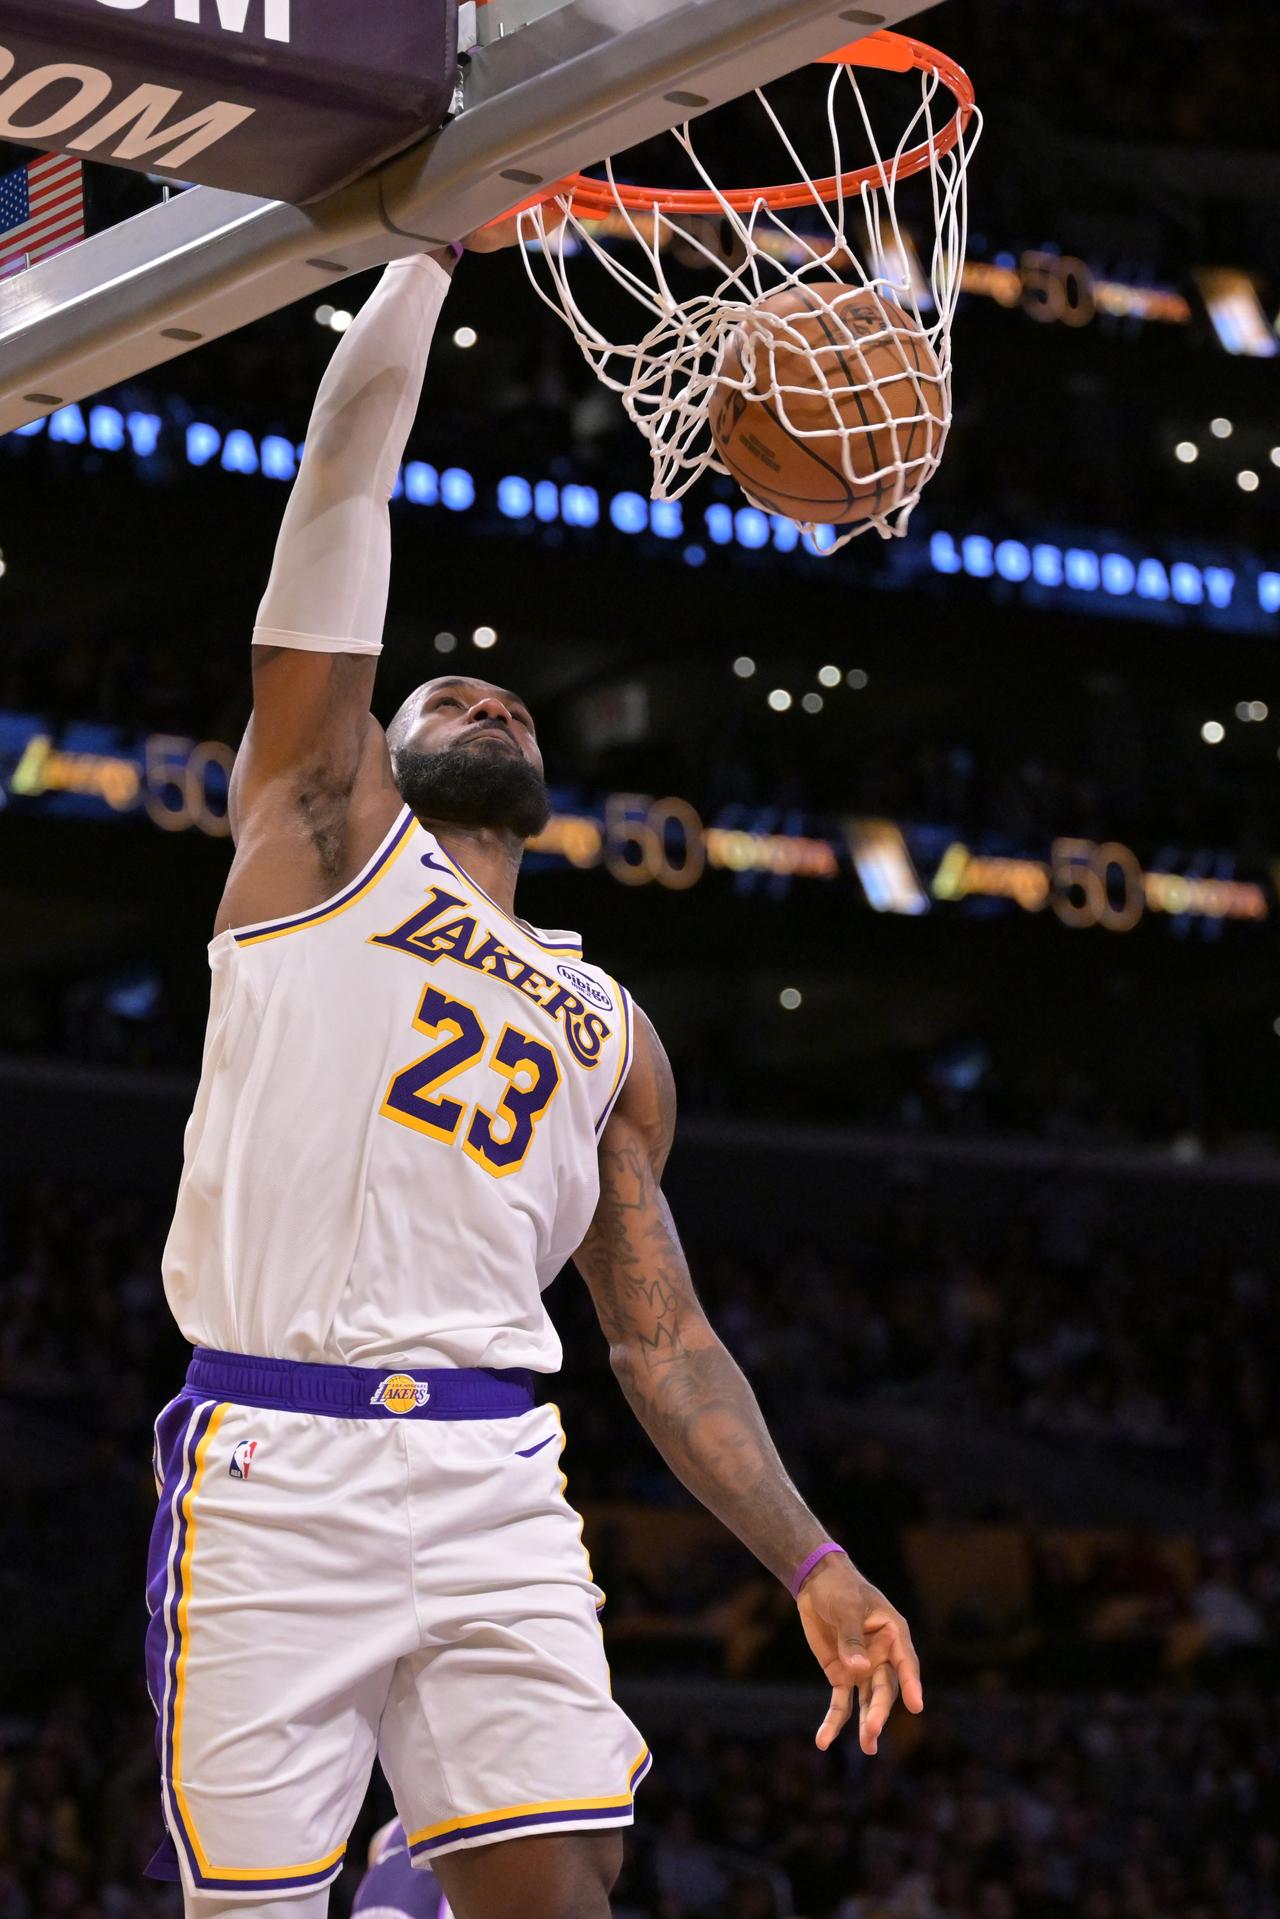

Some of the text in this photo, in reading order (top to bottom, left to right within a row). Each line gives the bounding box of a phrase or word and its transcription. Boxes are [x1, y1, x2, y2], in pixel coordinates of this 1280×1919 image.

[603, 791, 705, 890] 50
[1050, 836, 1146, 932] 50
[366, 885, 612, 1071] LAKERS
[561, 968, 610, 1006] bibigo
[379, 982, 562, 1179] 23
[370, 1383, 429, 1405] LAKERS
